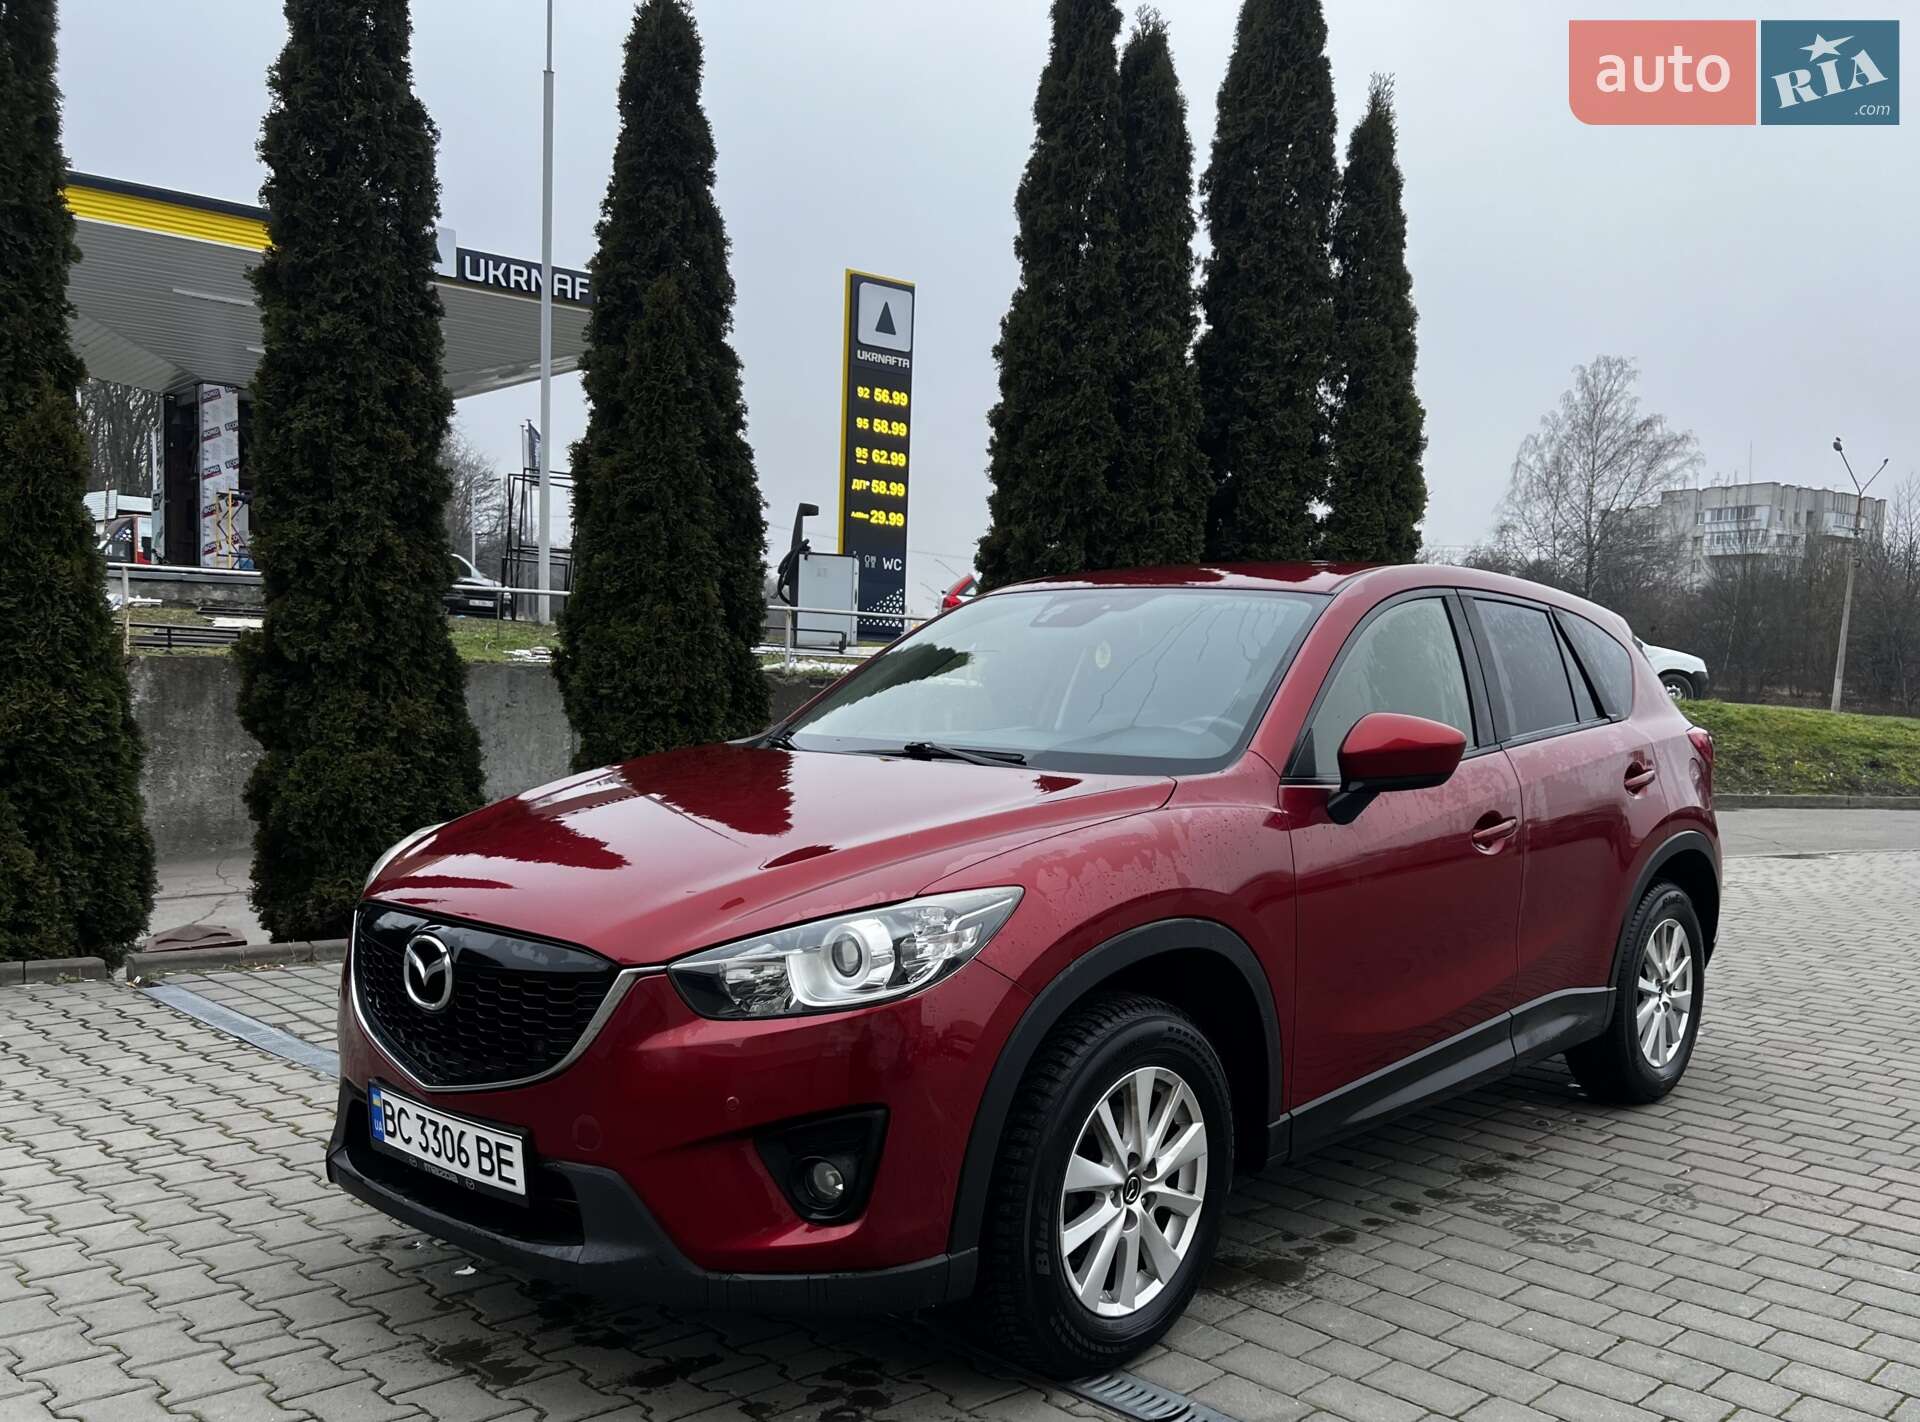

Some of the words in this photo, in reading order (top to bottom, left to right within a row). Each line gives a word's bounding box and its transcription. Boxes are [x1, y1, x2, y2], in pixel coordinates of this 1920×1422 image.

[464, 255, 590, 301] UKRNAF
[857, 350, 910, 369] UKRNAFTA
[857, 386, 870, 399] 92
[874, 387, 908, 406] 56.99
[856, 416, 869, 429] 95
[873, 418, 907, 436] 58.99
[872, 449, 907, 467] 62.99
[871, 479, 906, 496] 58.99
[870, 509, 905, 526] 29.99
[882, 557, 902, 571] WC
[374, 1119, 384, 1132] UA
[383, 1099, 412, 1145] BC
[416, 1113, 470, 1169] 3306
[476, 1134, 517, 1187] BE
